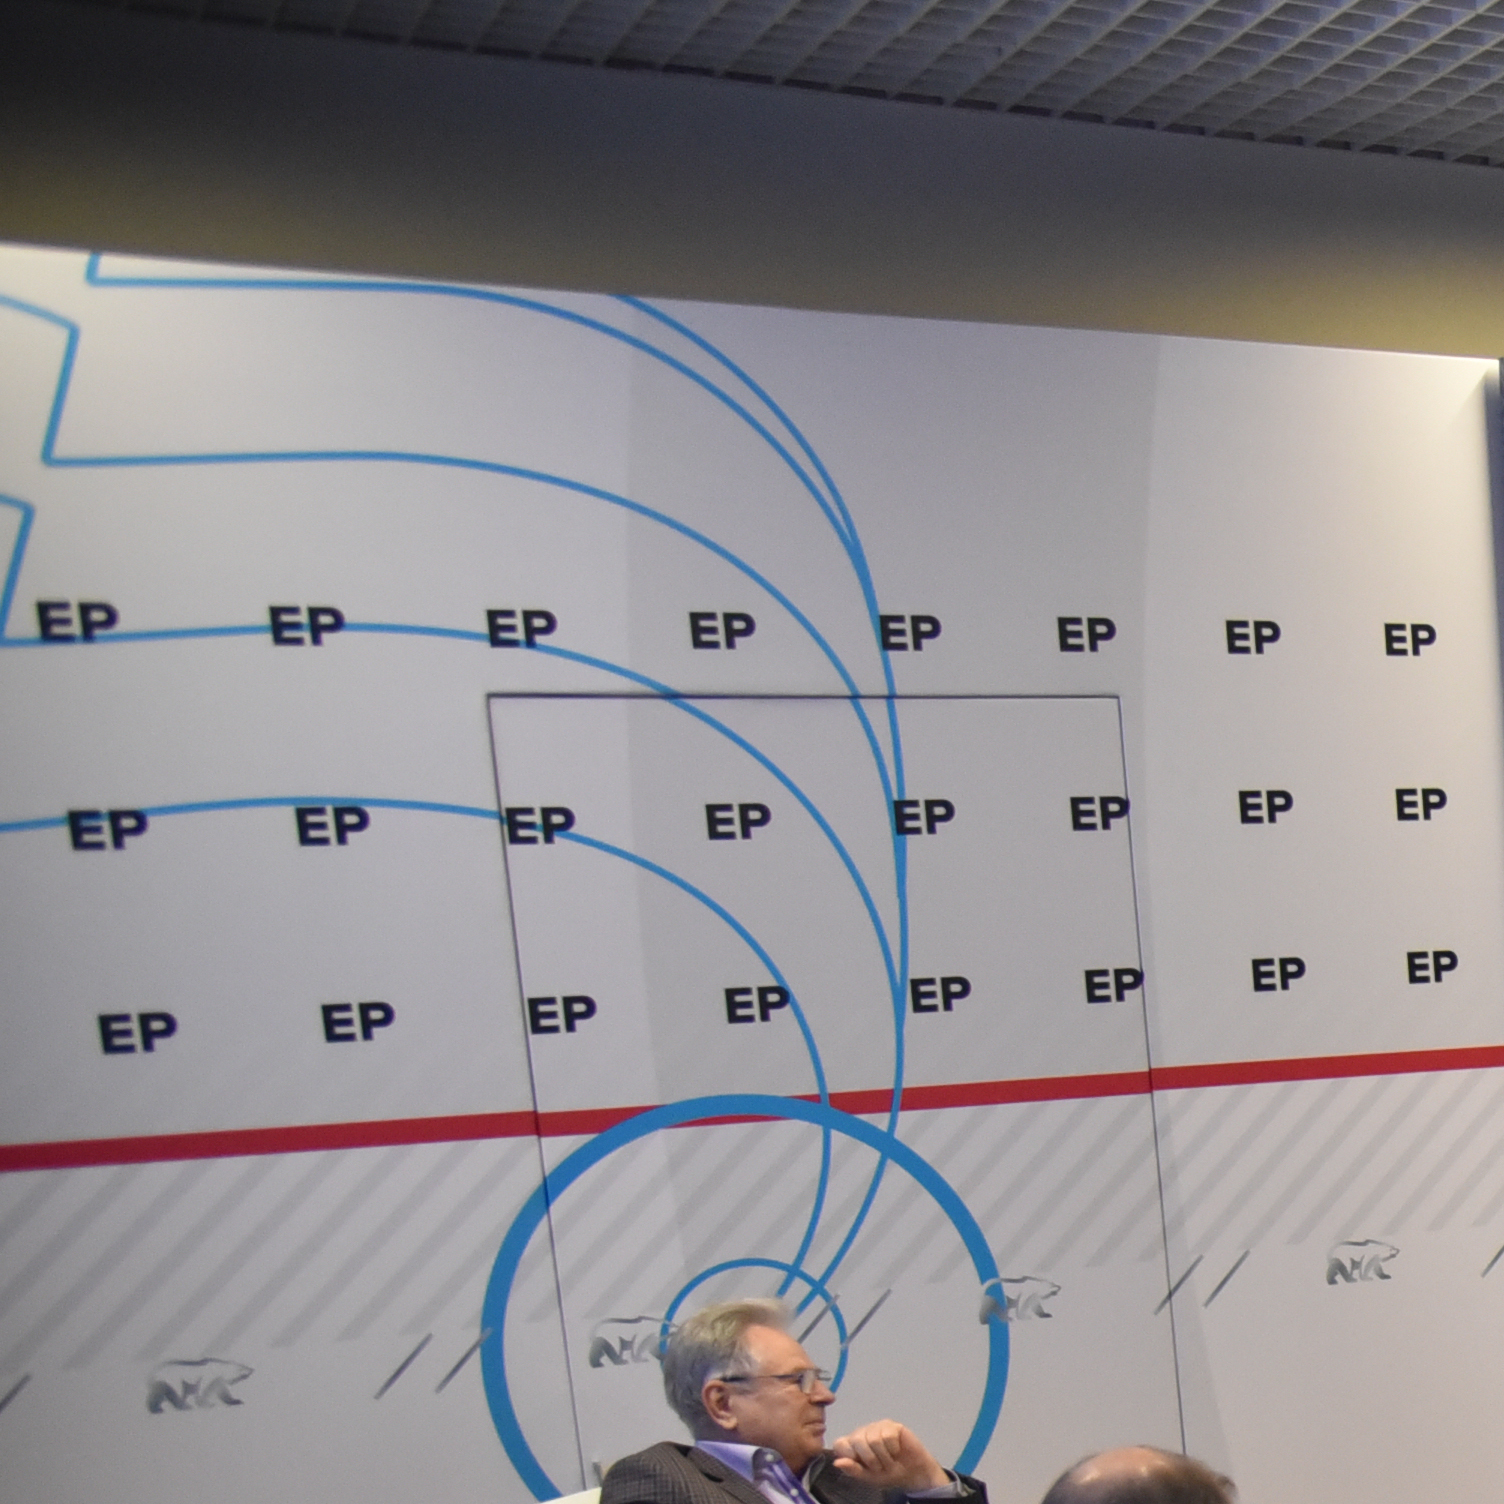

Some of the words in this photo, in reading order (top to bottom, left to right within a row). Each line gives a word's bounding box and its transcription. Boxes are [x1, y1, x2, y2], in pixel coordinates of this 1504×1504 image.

[37, 601, 119, 643] ЕР
[269, 606, 346, 646] ЕР
[487, 609, 558, 648] ЕР
[690, 611, 756, 649] ЕР
[880, 614, 942, 651] ЕР
[1058, 617, 1116, 652] ЕР
[1226, 620, 1281, 654] ЕР
[1385, 623, 1437, 656] ЕР
[68, 809, 148, 851] ЕР
[296, 806, 370, 846] ЕР
[506, 806, 576, 845] ЕР
[706, 803, 772, 840] ЕР
[894, 799, 955, 835] ЕР
[1071, 796, 1130, 831] ЕР
[1239, 790, 1294, 824] ЕР
[1396, 788, 1447, 821] ЕР
[99, 1012, 178, 1054] ЕР
[322, 1002, 396, 1043] ЕР
[528, 995, 598, 1034] ЕР
[725, 985, 791, 1024] ЕР
[910, 976, 971, 1013] ЕР
[1085, 967, 1144, 1004] ЕР
[1252, 957, 1306, 992] ЕР
[1407, 950, 1459, 984] ЕР
